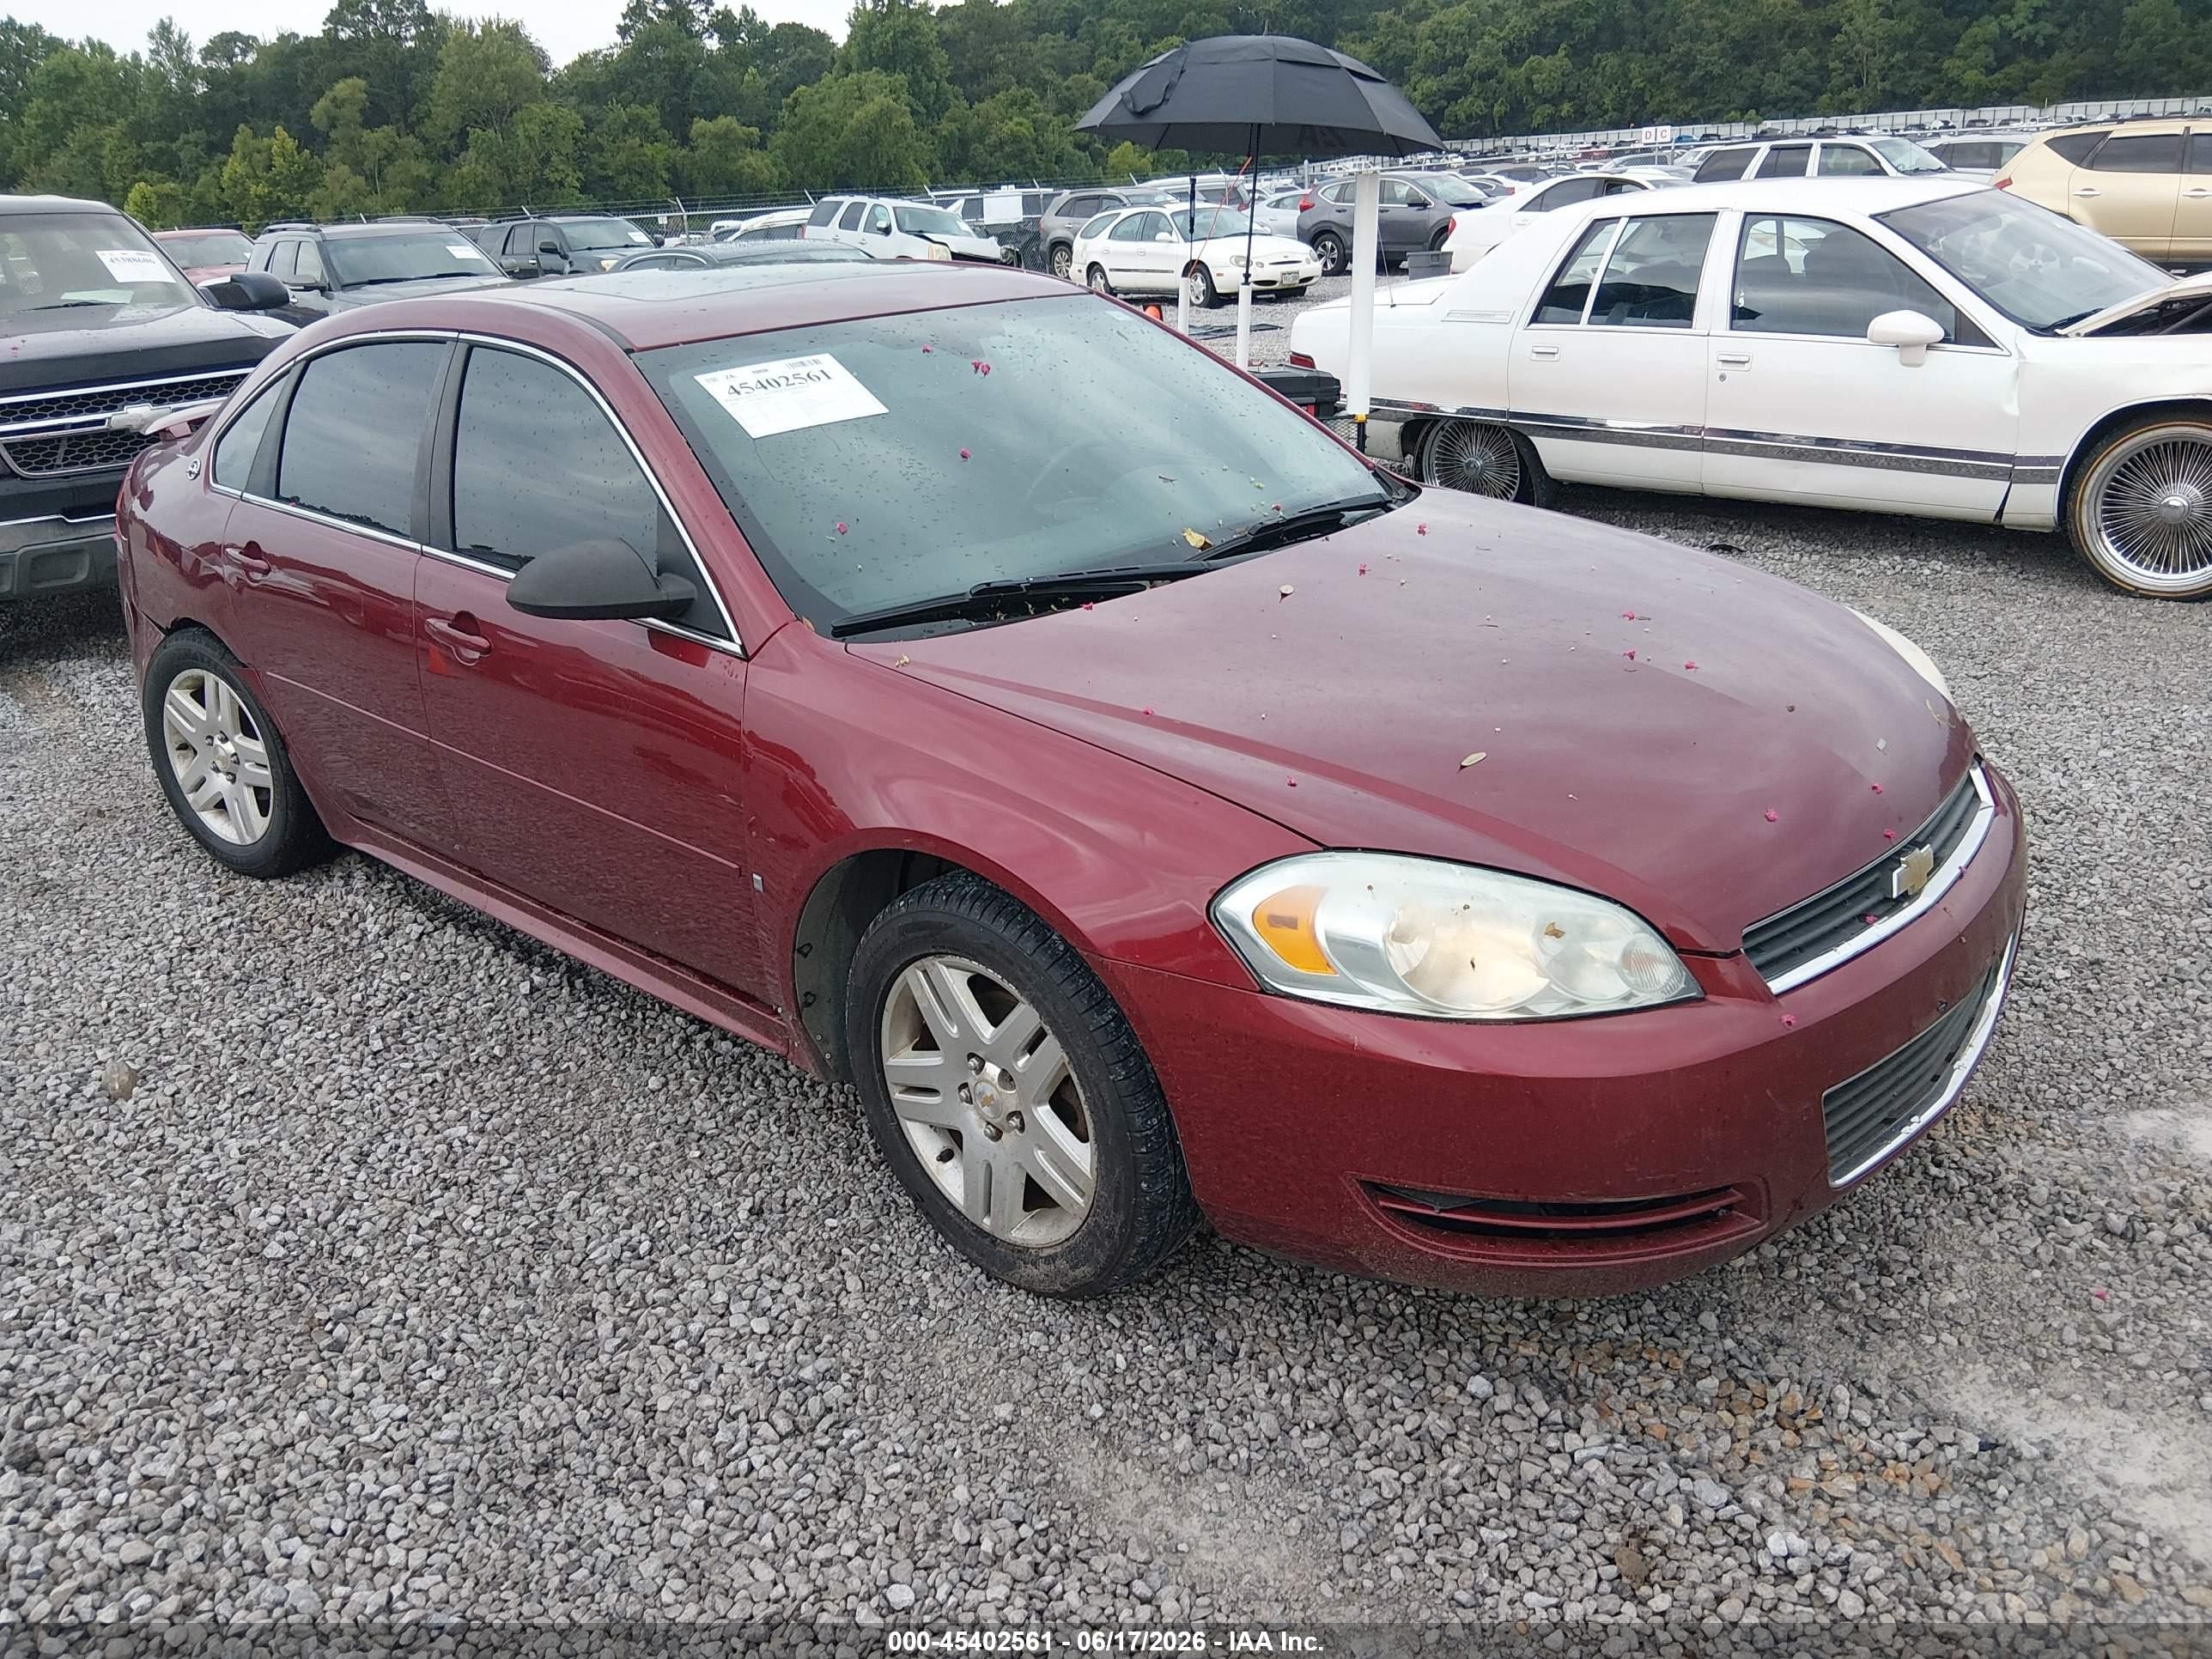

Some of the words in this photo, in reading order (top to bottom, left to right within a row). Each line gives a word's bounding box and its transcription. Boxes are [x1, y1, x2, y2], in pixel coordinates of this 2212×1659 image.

[1645, 131, 1652, 140] D
[1661, 129, 1668, 138] C
[727, 368, 832, 396] 45402561
